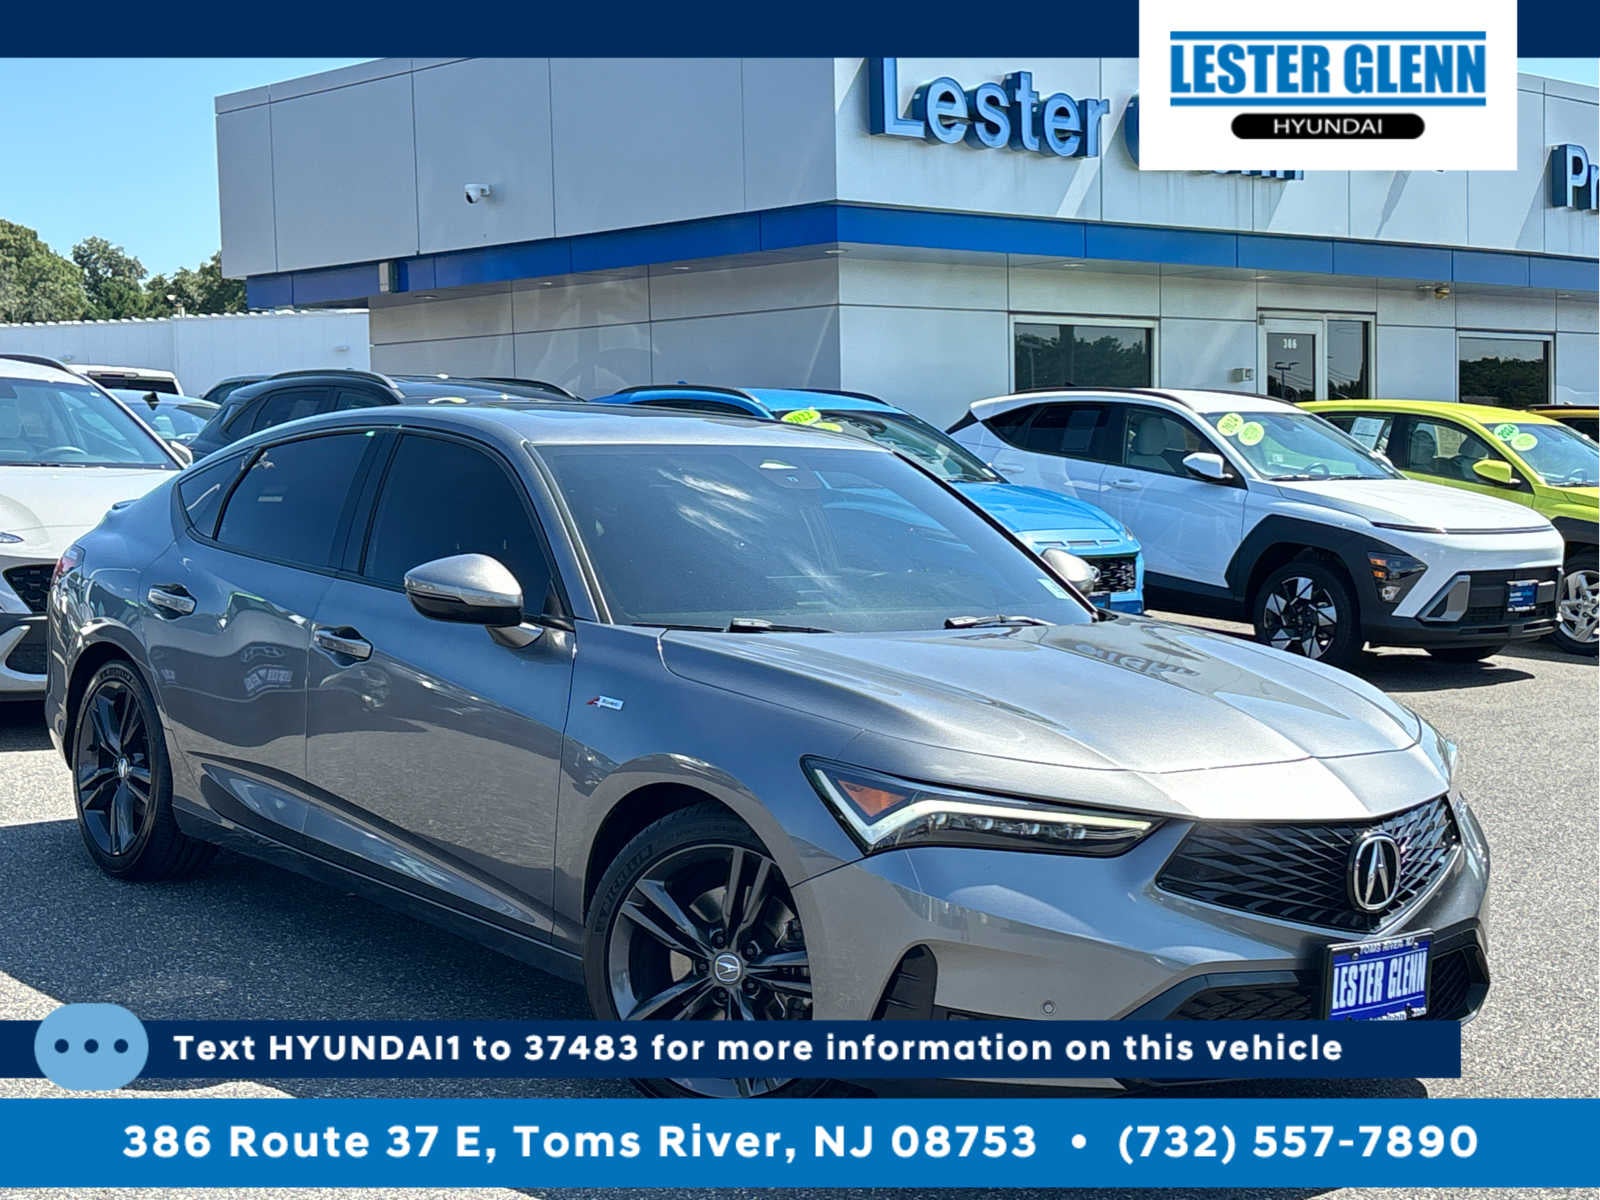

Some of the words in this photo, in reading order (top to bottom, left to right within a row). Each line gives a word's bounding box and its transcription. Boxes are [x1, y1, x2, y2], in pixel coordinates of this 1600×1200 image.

[870, 58, 1110, 158] Lester
[1282, 337, 1298, 350] 386
[1332, 961, 1384, 1009] LESTER
[1387, 951, 1427, 999] GLENN
